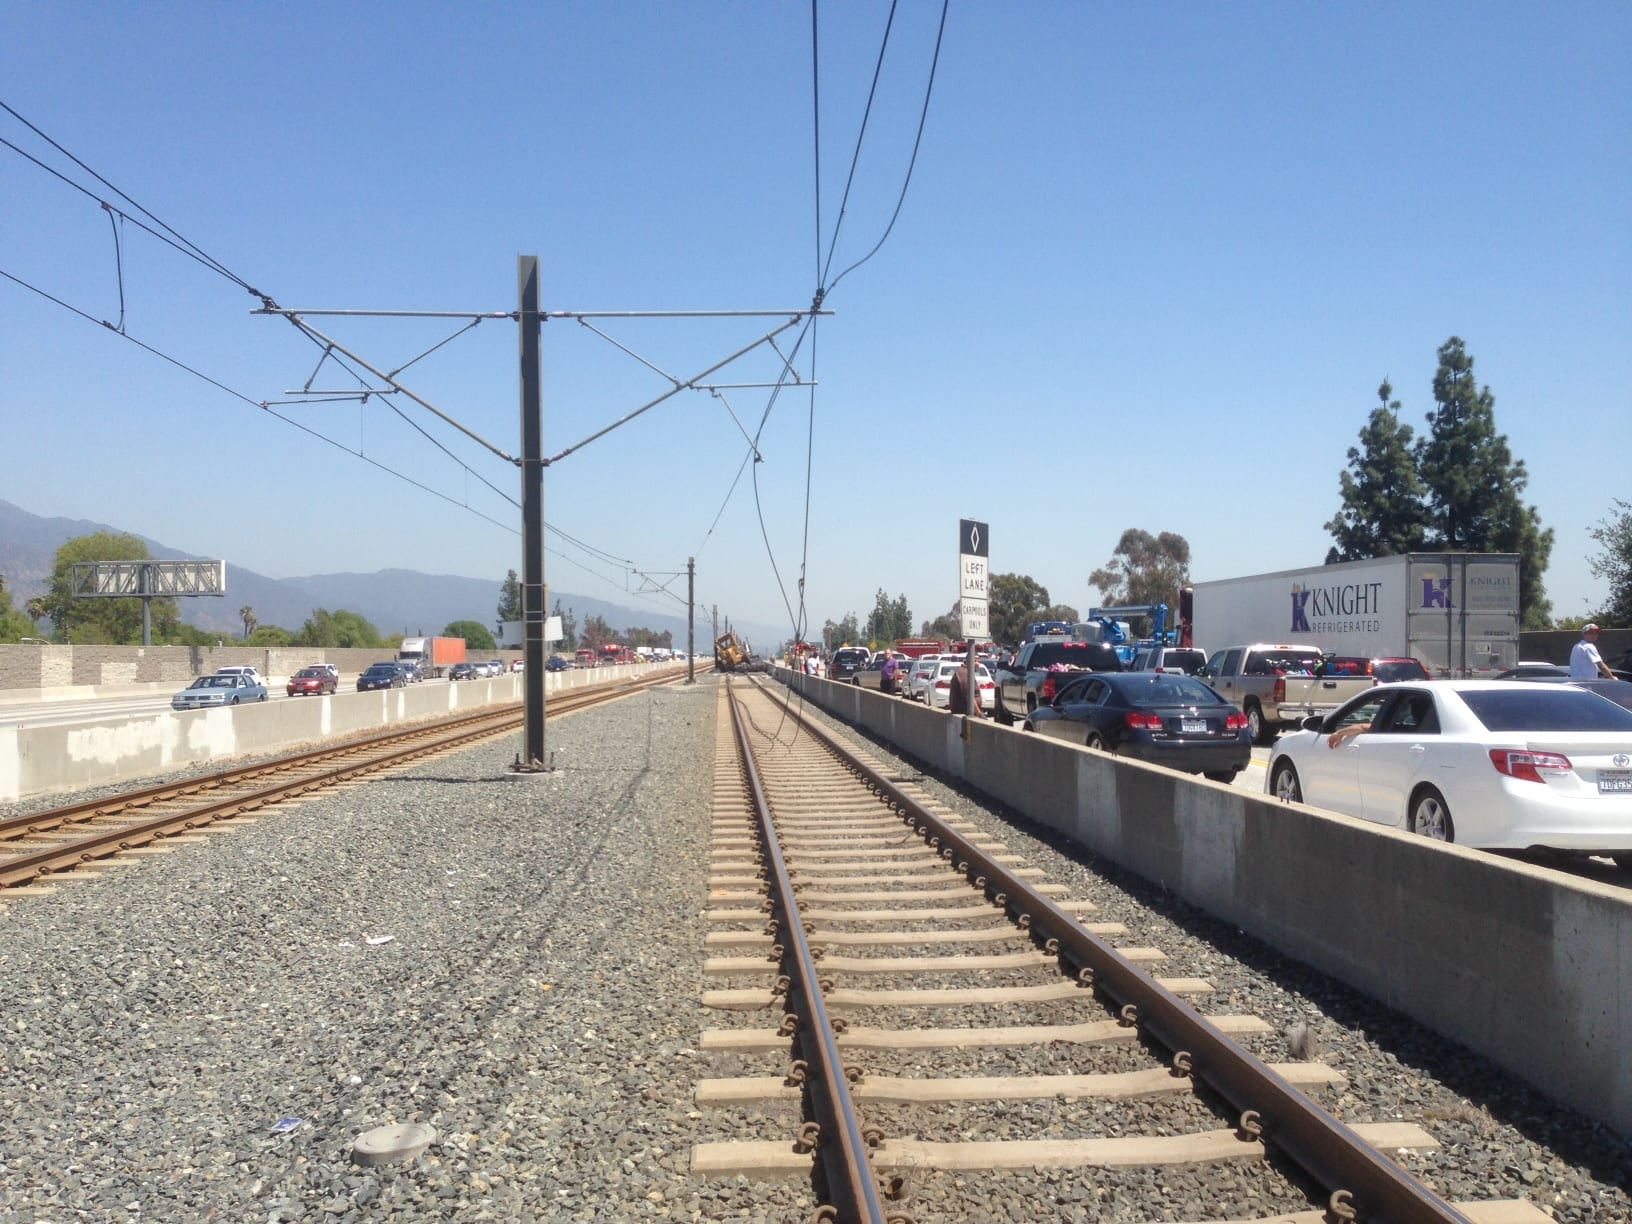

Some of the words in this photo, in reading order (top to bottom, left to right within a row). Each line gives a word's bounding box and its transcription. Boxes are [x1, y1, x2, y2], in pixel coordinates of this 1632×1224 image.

[965, 562, 984, 575] LEFT
[964, 579, 985, 591] LANE
[1312, 583, 1383, 617] KNIGHT
[962, 605, 987, 617] CARPOOLS
[969, 620, 981, 630] ONLY
[1312, 620, 1381, 634] REFRIGERATED
